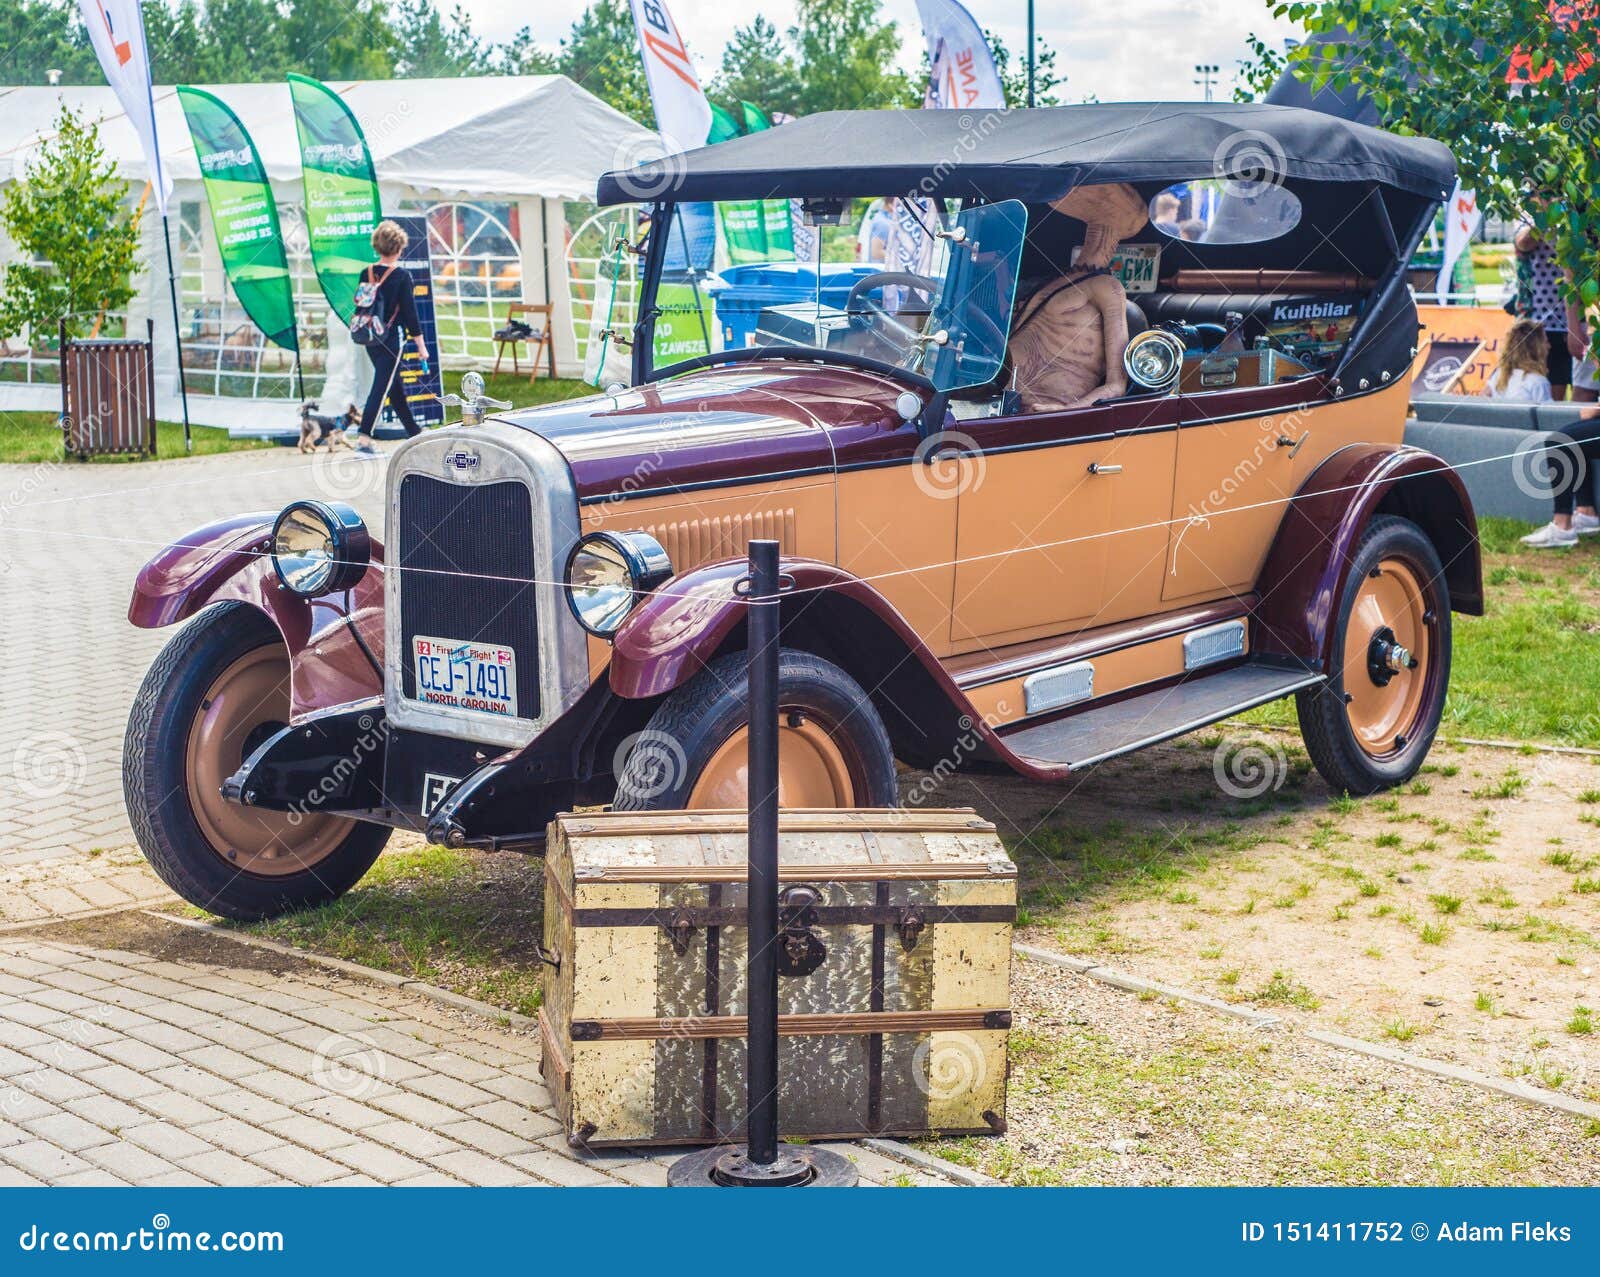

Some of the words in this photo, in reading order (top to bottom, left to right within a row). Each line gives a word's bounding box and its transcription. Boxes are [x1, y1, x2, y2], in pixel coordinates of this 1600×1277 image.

[1273, 303, 1352, 321] Kultbilar
[419, 656, 511, 701] CEJ-1491
[425, 692, 458, 707] NORTH
[460, 697, 508, 714] CAROLINA
